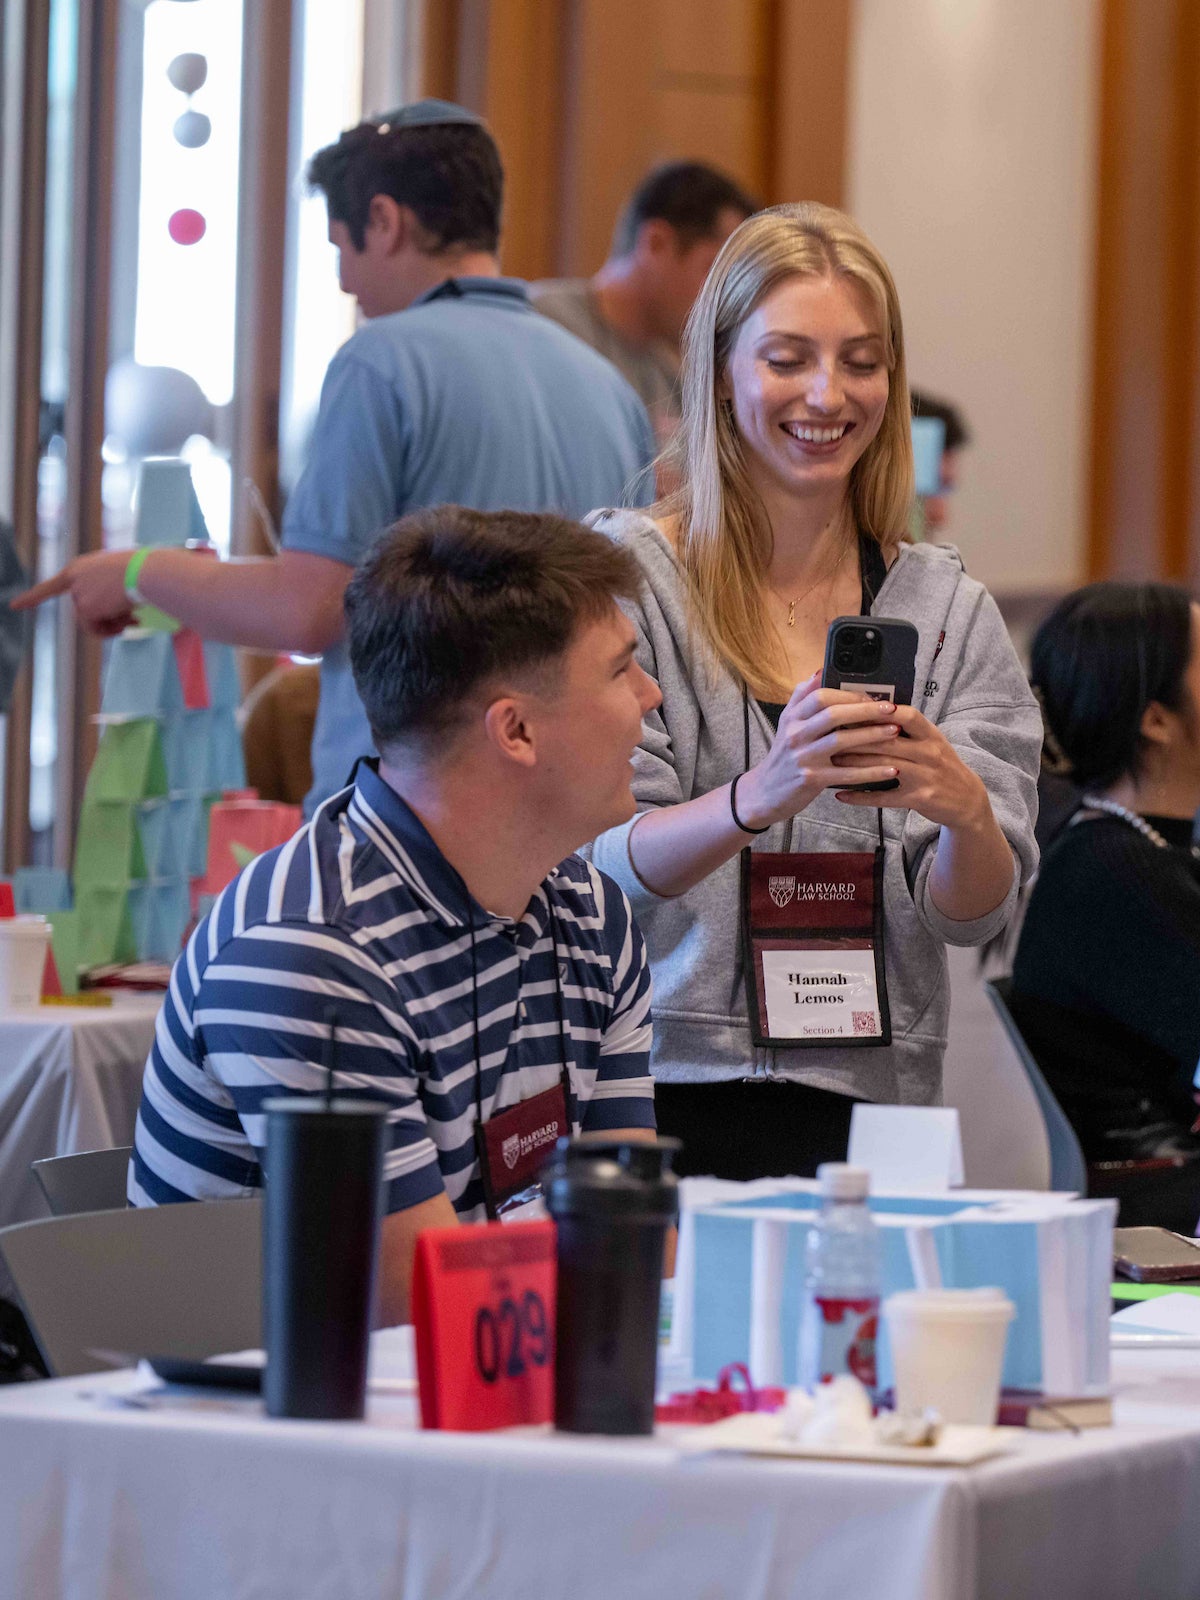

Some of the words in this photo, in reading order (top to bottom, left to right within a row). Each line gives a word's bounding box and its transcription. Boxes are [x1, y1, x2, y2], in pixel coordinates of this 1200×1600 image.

[797, 882, 856, 893] HARVARD
[797, 892, 816, 901] LAW
[818, 892, 856, 901] SCHOOL
[788, 973, 848, 986] Hannah
[794, 991, 845, 1004] Lemos
[803, 1025, 834, 1035] Section
[837, 1025, 844, 1035] 4
[520, 1121, 559, 1149] HARVARD
[474, 1289, 549, 1384] 029
